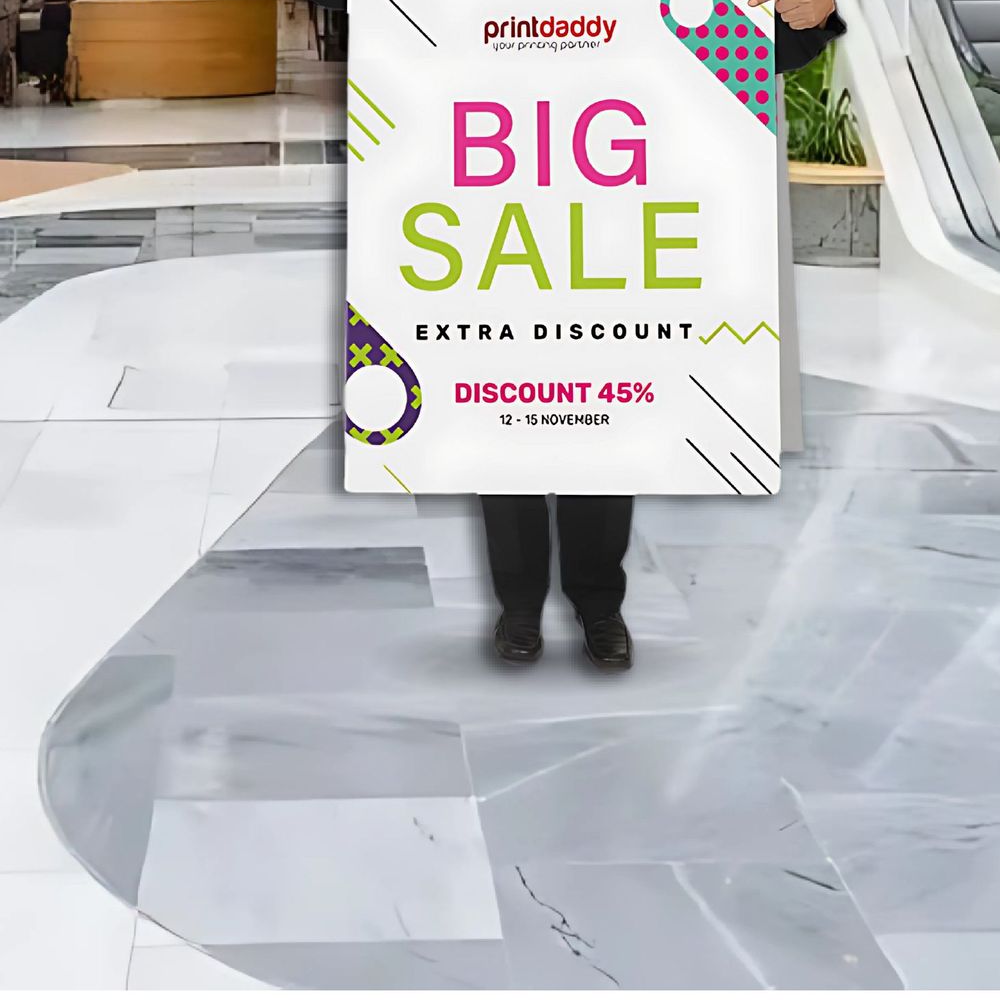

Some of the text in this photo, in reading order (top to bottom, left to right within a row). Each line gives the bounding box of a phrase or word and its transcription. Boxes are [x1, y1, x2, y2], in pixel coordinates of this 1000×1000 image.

[484, 16, 617, 43] printdaddy
[453, 99, 647, 188] BIG
[399, 201, 703, 292] SALE
[416, 322, 693, 341] EXTRA DISCOUNT
[455, 382, 655, 404] DISCOUNT 45%
[499, 413, 513, 426] 12
[525, 413, 538, 426] 15
[541, 413, 610, 426] NOVEMBER
